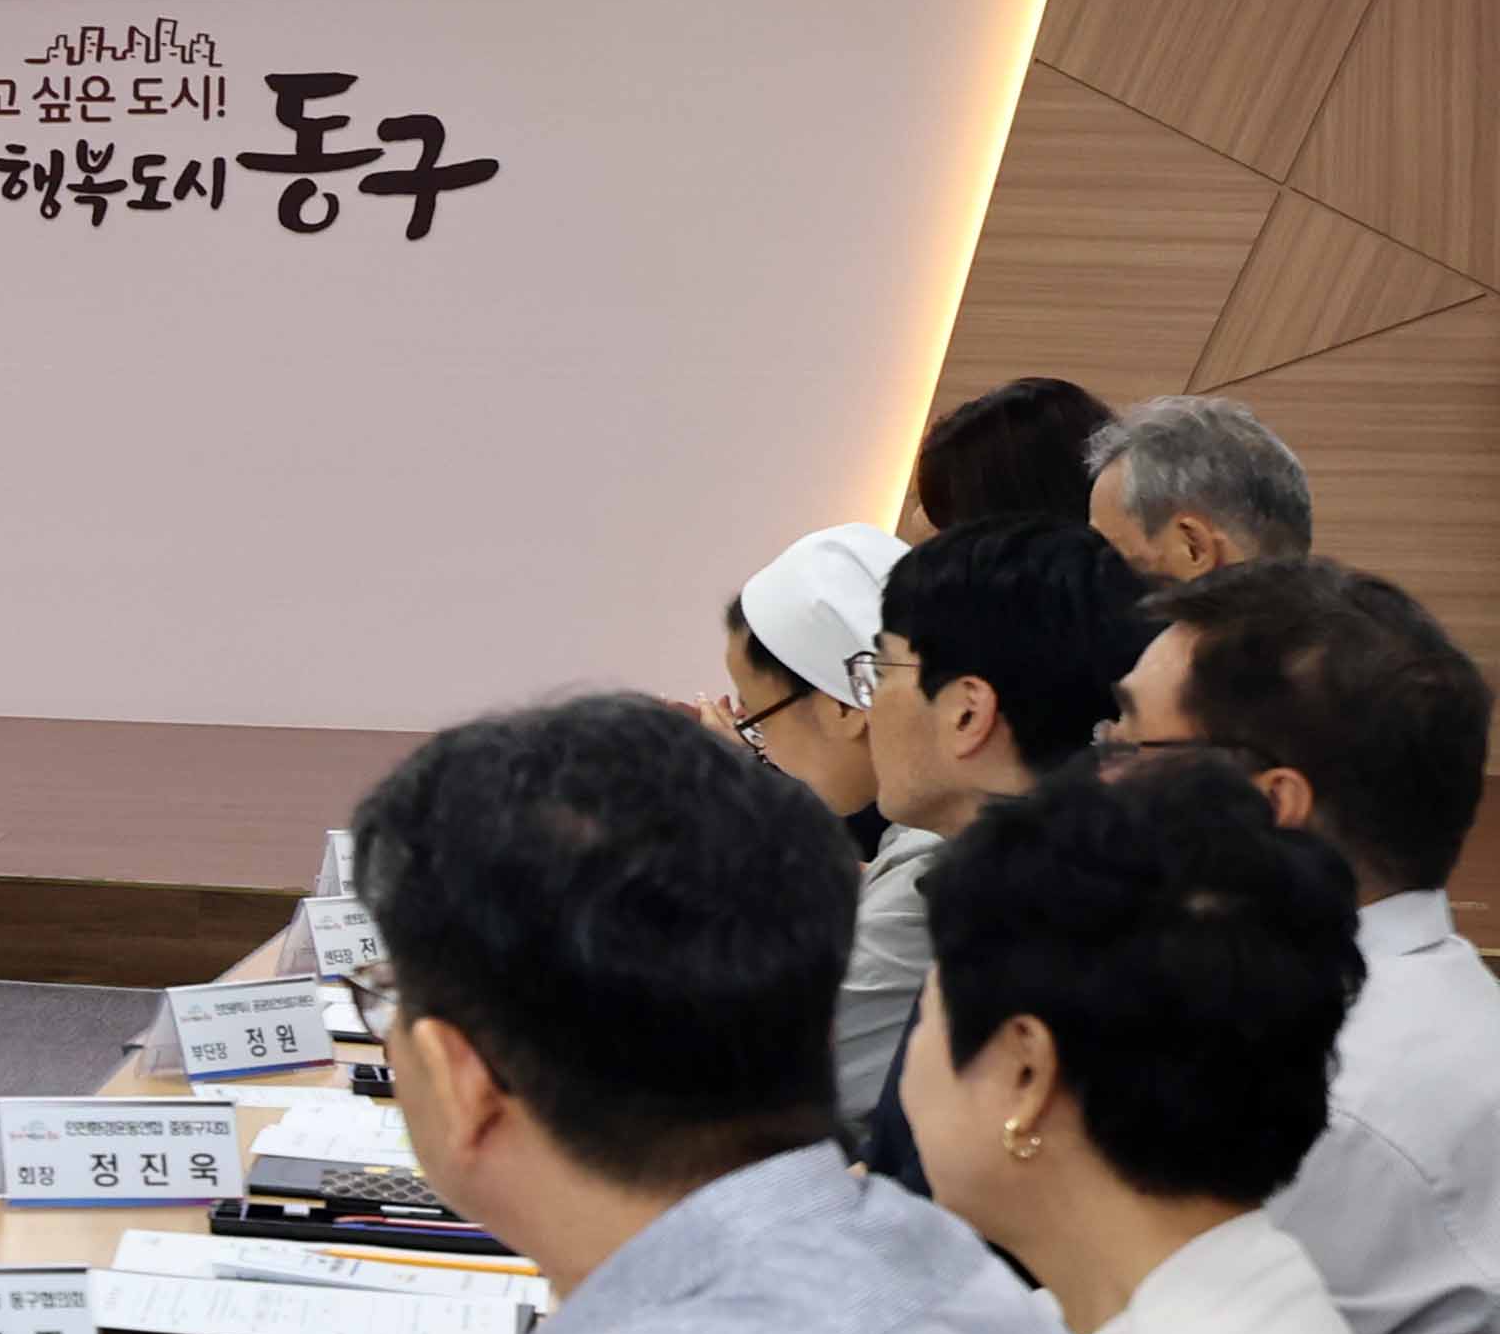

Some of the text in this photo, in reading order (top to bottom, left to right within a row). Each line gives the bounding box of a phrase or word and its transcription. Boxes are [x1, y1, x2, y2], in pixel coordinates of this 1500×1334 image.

[32, 75, 116, 124] 싶은
[127, 74, 226, 121] 도시!
[235, 72, 500, 241] 동구
[18, 1166, 55, 1187] 회장
